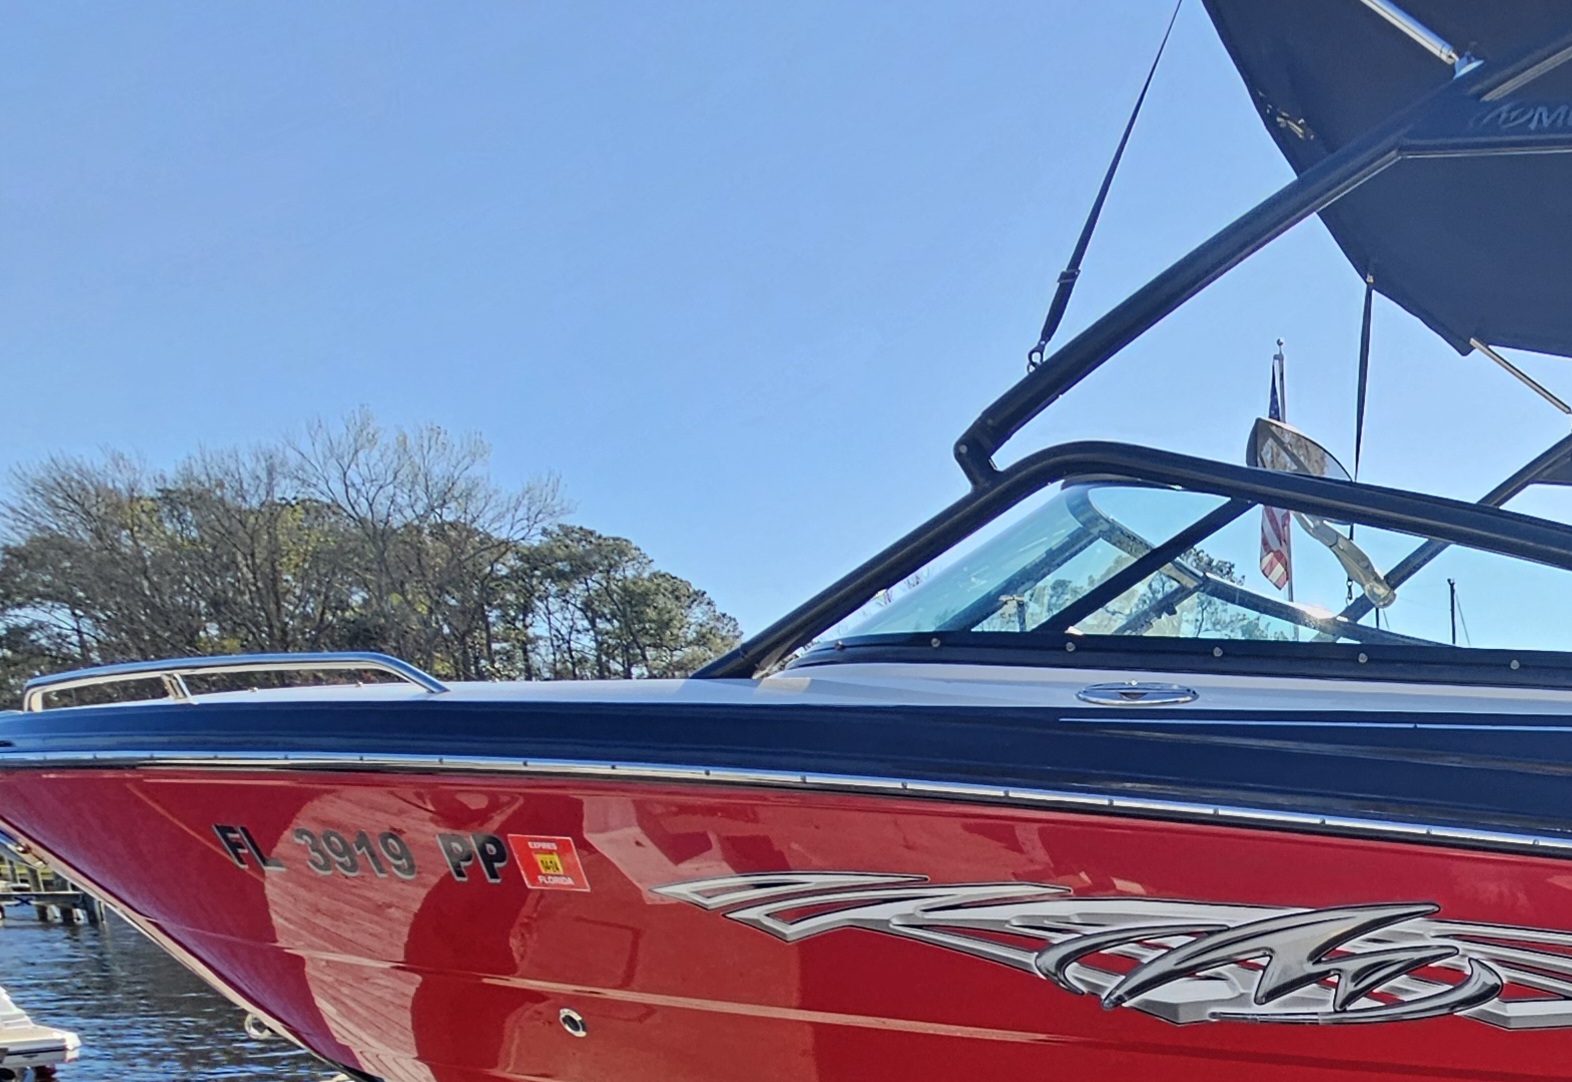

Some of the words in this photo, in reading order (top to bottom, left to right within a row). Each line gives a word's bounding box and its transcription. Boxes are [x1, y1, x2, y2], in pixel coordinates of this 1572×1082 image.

[211, 823, 287, 872] FL
[293, 827, 417, 880] 3919
[436, 833, 508, 883] PP
[537, 875, 575, 885] FLORIDA
